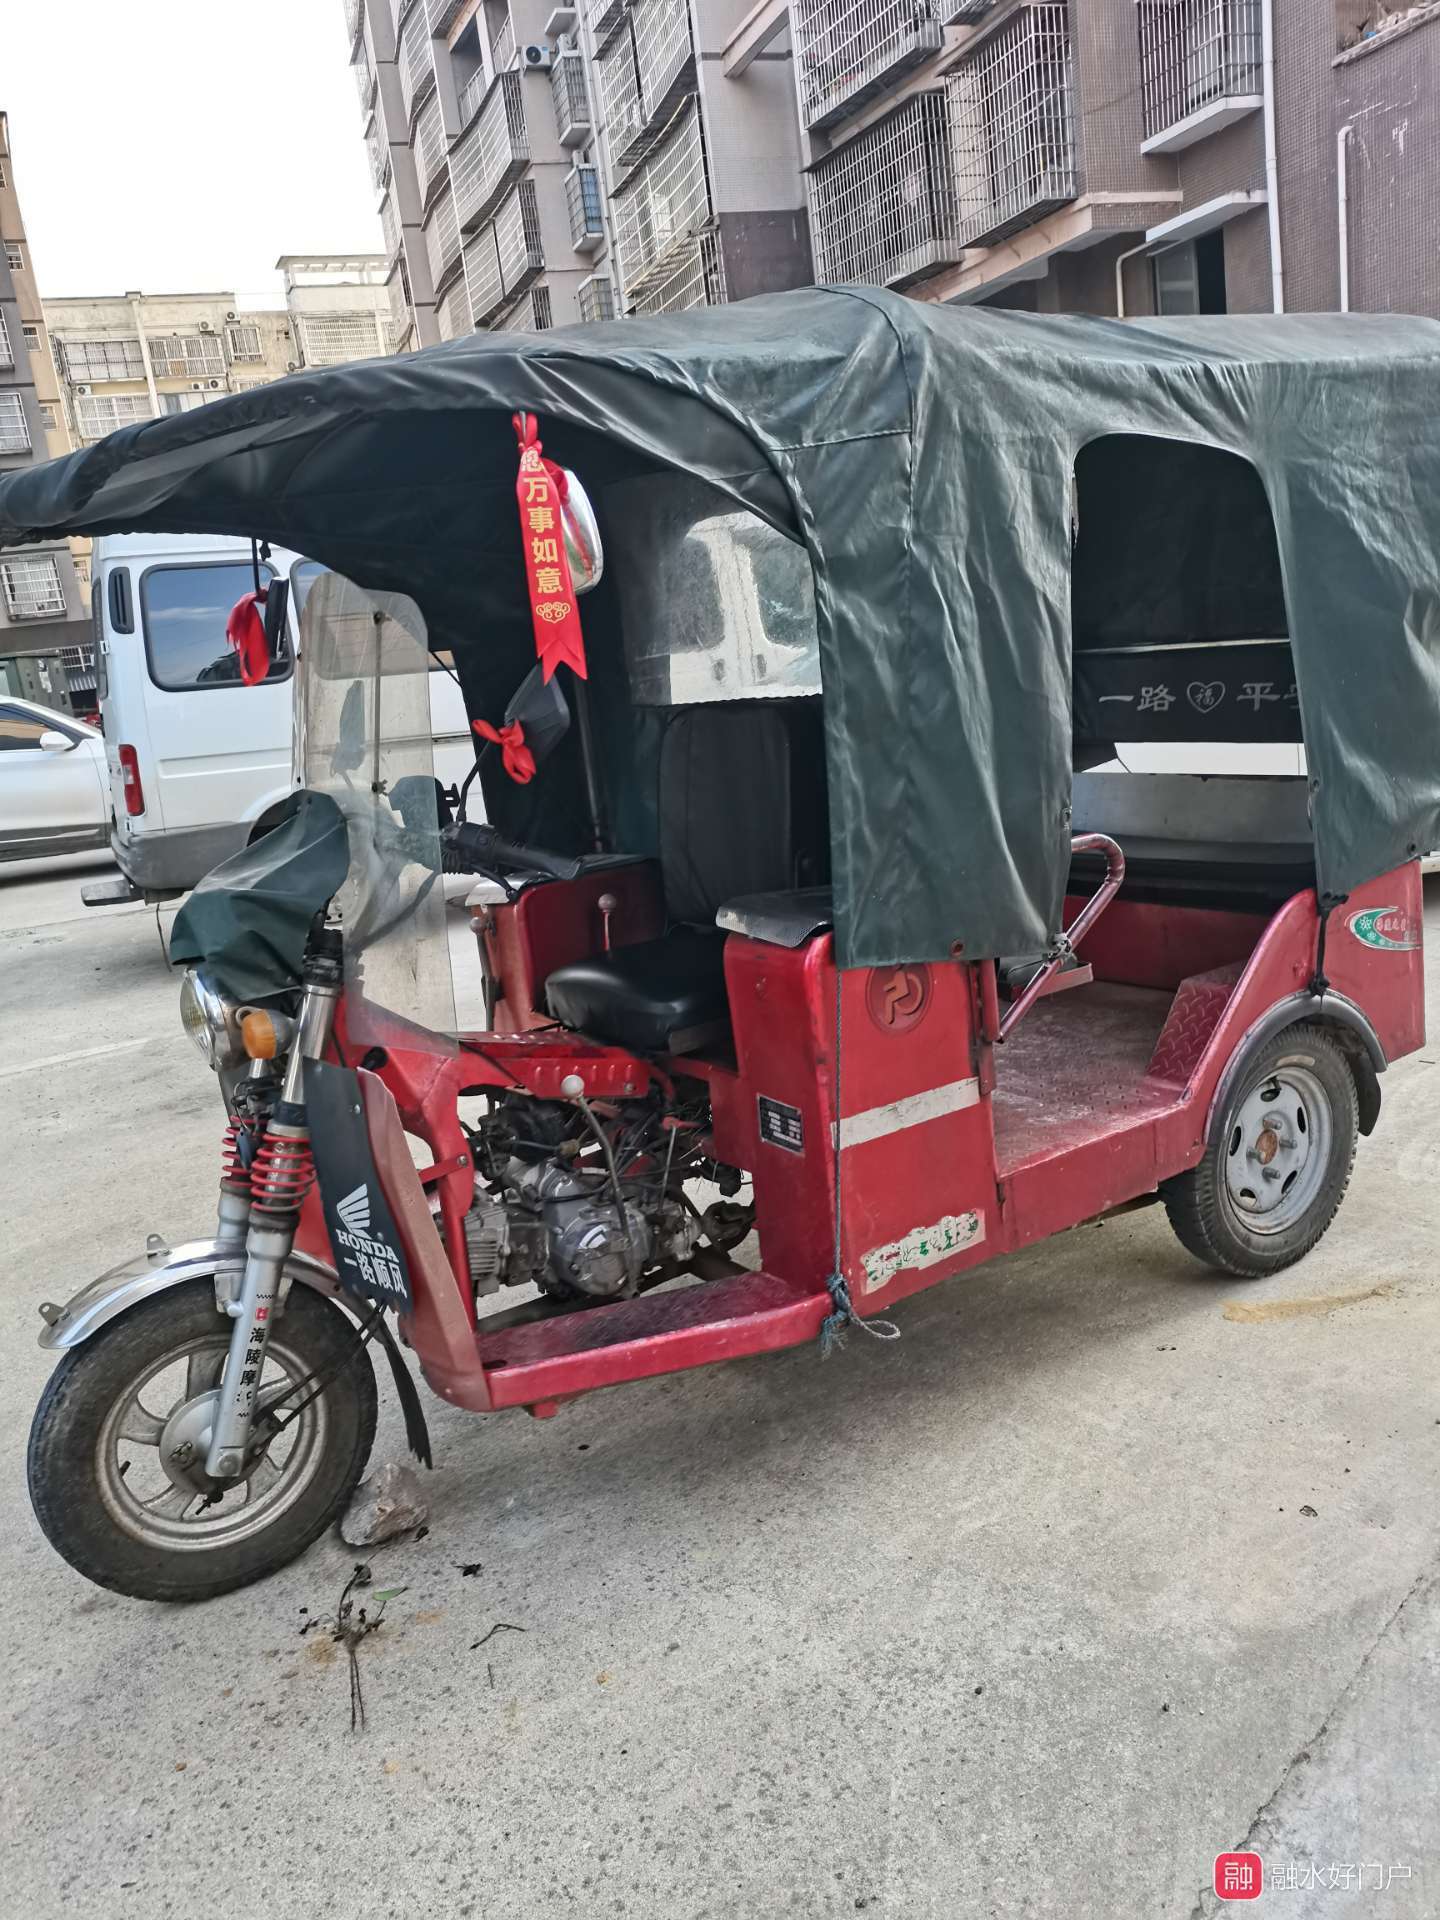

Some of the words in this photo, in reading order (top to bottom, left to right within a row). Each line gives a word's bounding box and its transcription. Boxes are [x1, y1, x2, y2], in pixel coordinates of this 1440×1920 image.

[1099, 684, 1176, 712] 一路
[336, 1229, 399, 1263] HONDA
[344, 1251, 407, 1299] 一路顺风
